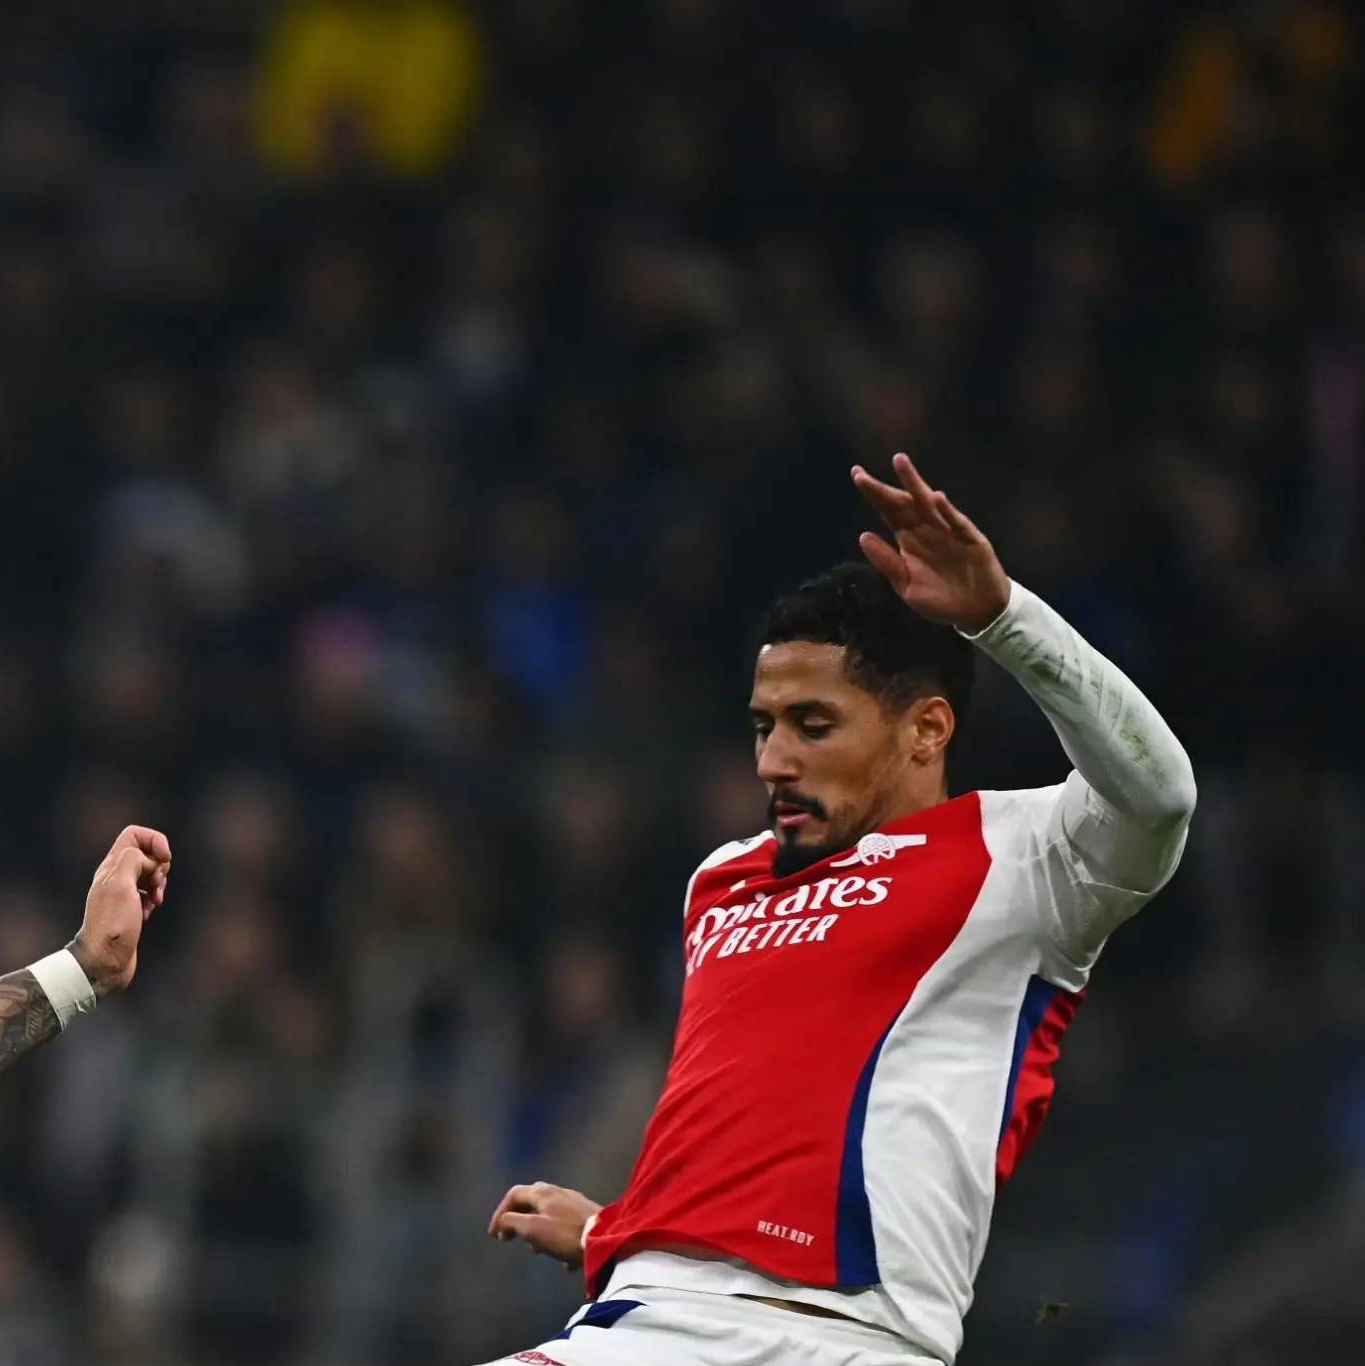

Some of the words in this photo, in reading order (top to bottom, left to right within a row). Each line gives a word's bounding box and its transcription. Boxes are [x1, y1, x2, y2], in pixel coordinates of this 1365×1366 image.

[691, 876, 893, 946] mirates
[716, 914, 839, 959] BETTER
[757, 1220, 815, 1246] HEAT.RDY
